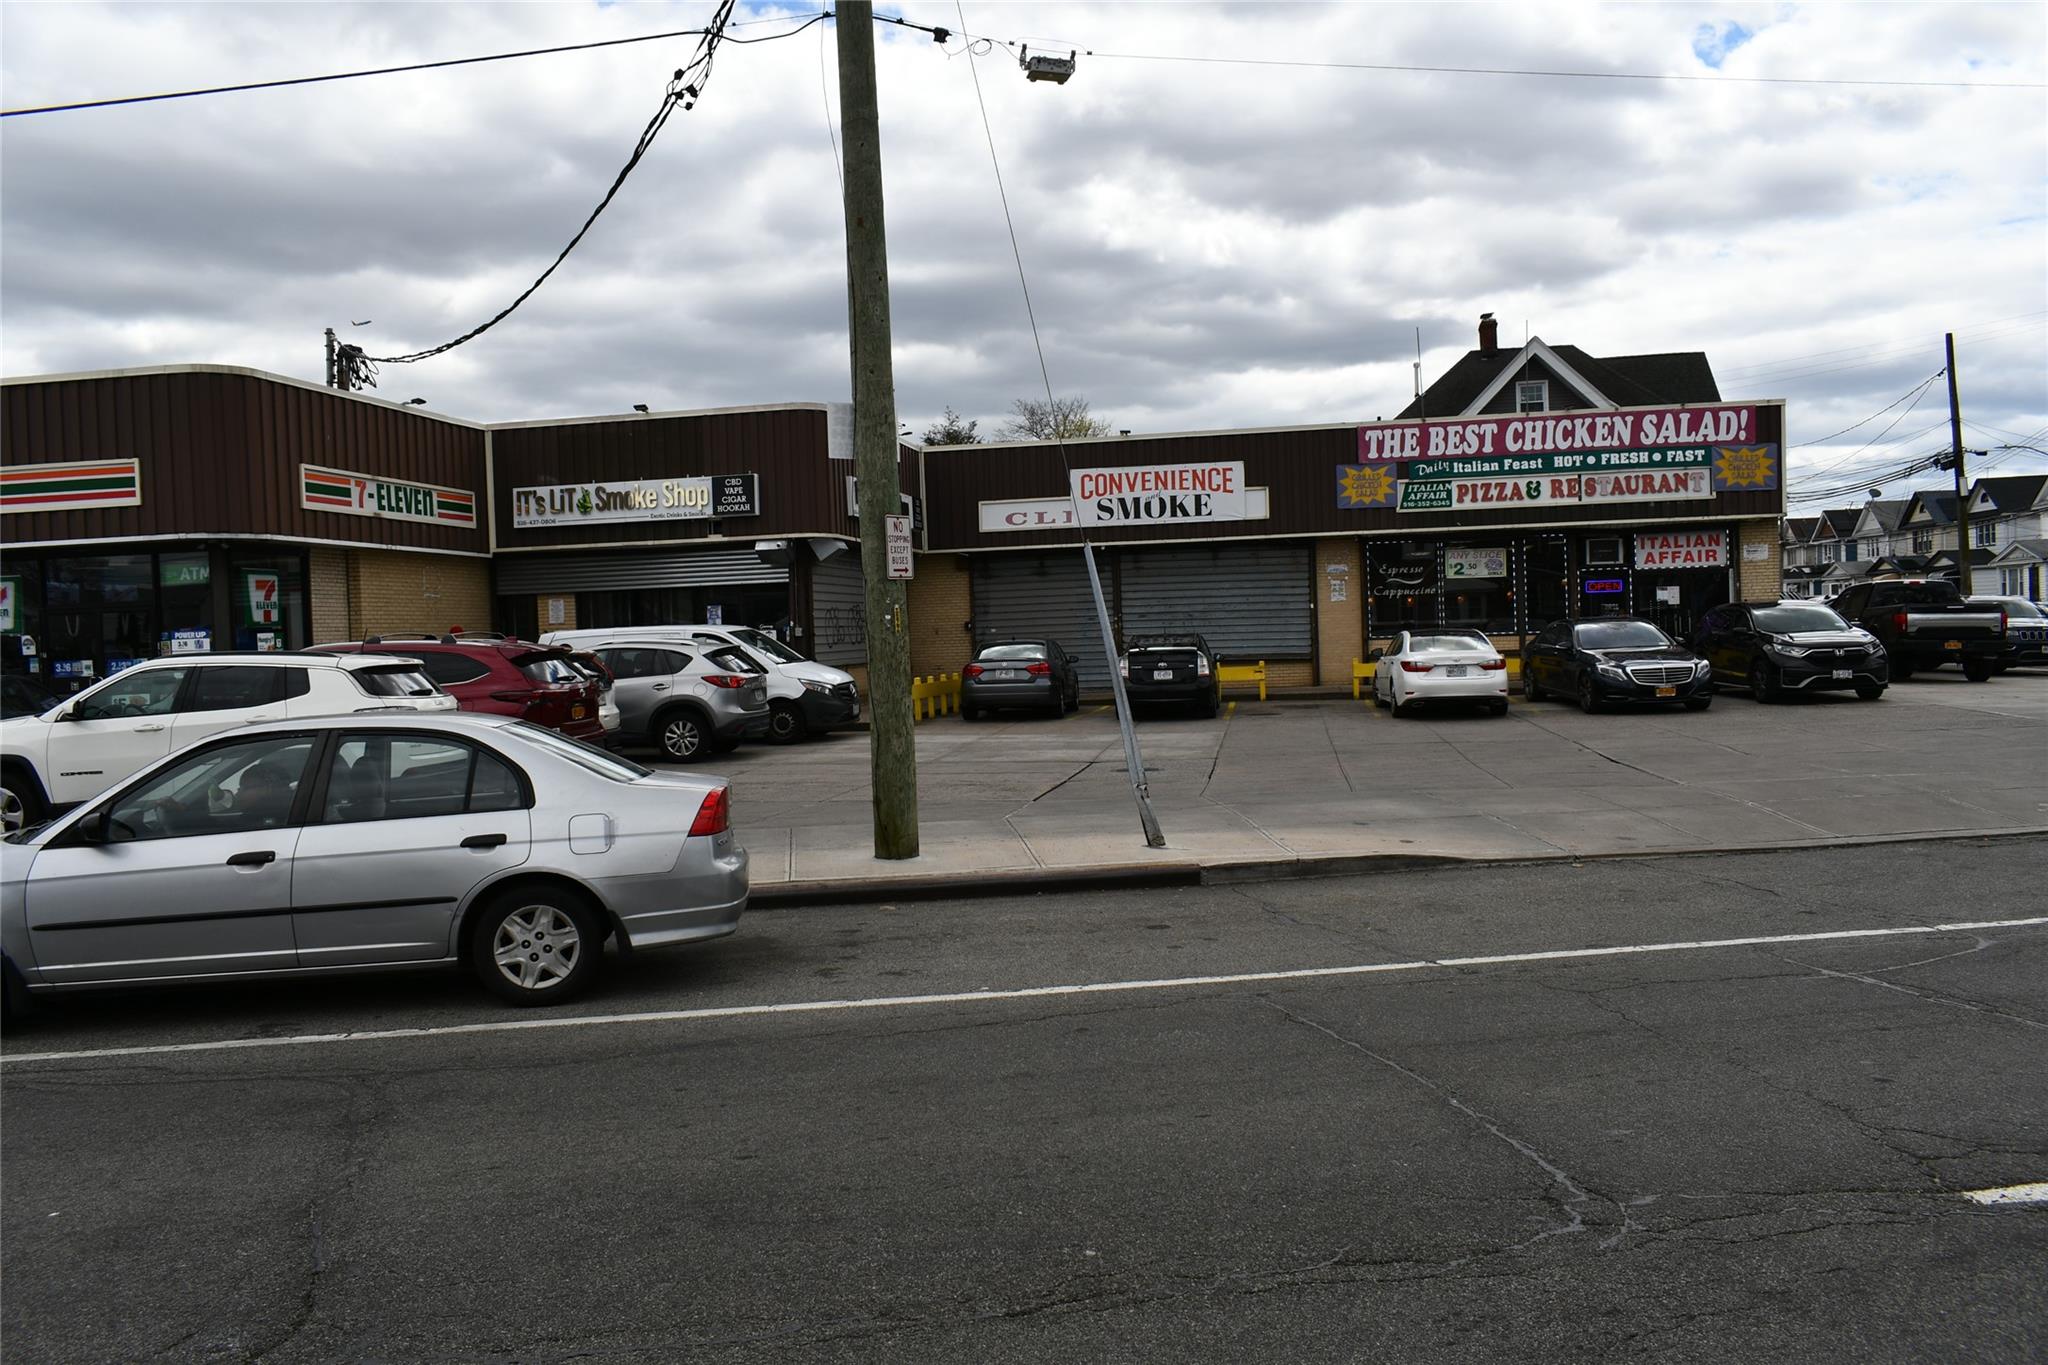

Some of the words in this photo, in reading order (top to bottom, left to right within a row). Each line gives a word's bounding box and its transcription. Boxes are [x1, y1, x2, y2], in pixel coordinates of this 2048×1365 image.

[1364, 426, 1420, 459] THE
[1427, 422, 1497, 456] BEST
[1505, 413, 1634, 452] CHICKEN
[1640, 408, 1749, 446] SALAD!
[1415, 461, 1449, 476] Daily
[1453, 460, 1499, 473] Italian
[1504, 457, 1543, 471] Feast
[1553, 454, 1583, 468] HOT
[1601, 451, 1649, 466] FRESH
[1667, 449, 1706, 463] FAST
[724, 478, 742, 486] CBD
[1080, 467, 1234, 500] CONVENIENCE
[1408, 483, 1452, 492] ITALIAN
[724, 486, 744, 494] VAPE
[1456, 482, 1525, 504] PIZZA
[1550, 472, 1705, 499] RESTAURANT
[595, 483, 657, 512] Smoke
[662, 480, 709, 513] Shop
[721, 495, 747, 504] CIGAR
[1145, 488, 1161, 503] and
[1408, 491, 1447, 500] AFFAIR
[717, 503, 750, 512] HOOKAH
[1096, 493, 1213, 521] SMOKE
[893, 521, 904, 533] NO
[888, 535, 910, 544] STOPPING
[1640, 534, 1720, 550] ITALIAN
[890, 545, 909, 554] EXCEPT
[1449, 551, 1470, 560] ANY
[1472, 550, 1502, 559] SLICE
[892, 556, 908, 565] BUSES
[1643, 549, 1718, 565] AFFAIR
[1379, 563, 1424, 577] Espresso
[1588, 582, 1620, 591] OPEN
[1373, 586, 1436, 599] Cappuccino
[174, 631, 195, 639] POWER
